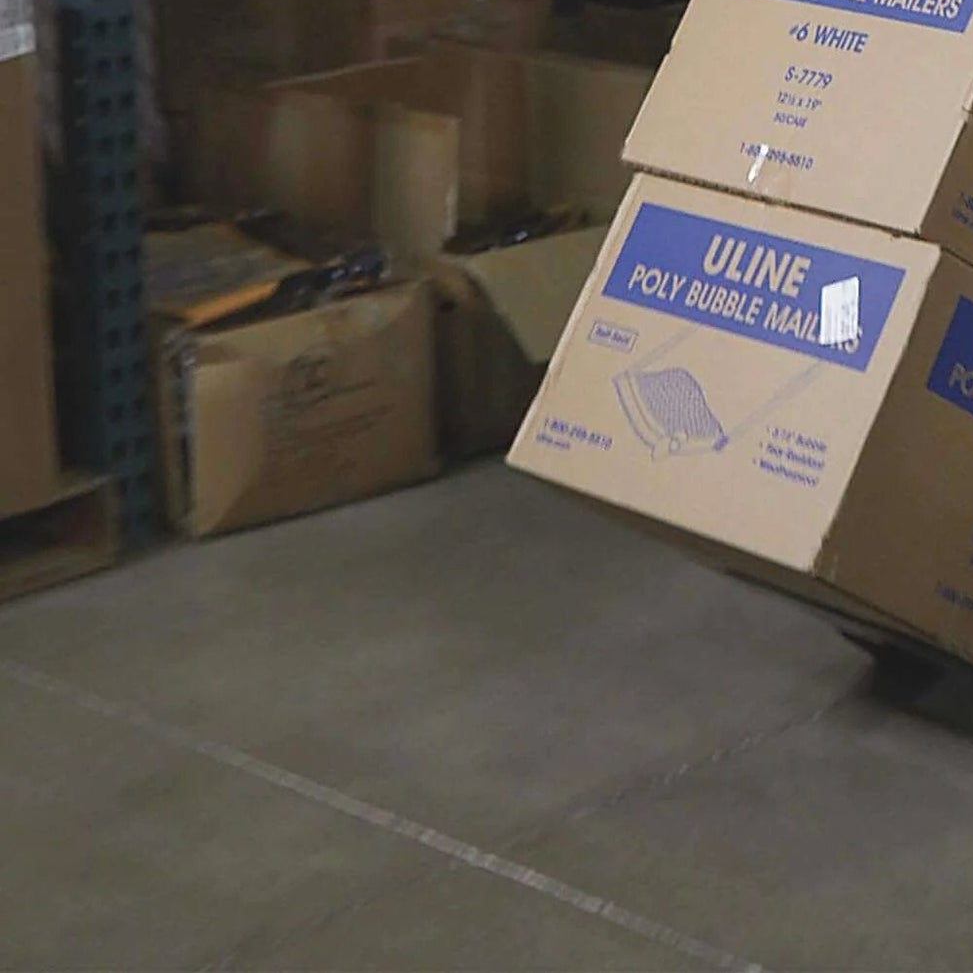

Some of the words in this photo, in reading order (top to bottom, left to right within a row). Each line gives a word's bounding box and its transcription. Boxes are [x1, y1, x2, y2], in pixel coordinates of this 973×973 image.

[813, 25, 869, 54] WHITE
[784, 66, 833, 89] S-7779
[703, 233, 811, 298] ULINE
[627, 264, 687, 302] POLY
[685, 281, 764, 326] BUBBLE
[764, 301, 863, 354] MAILS
